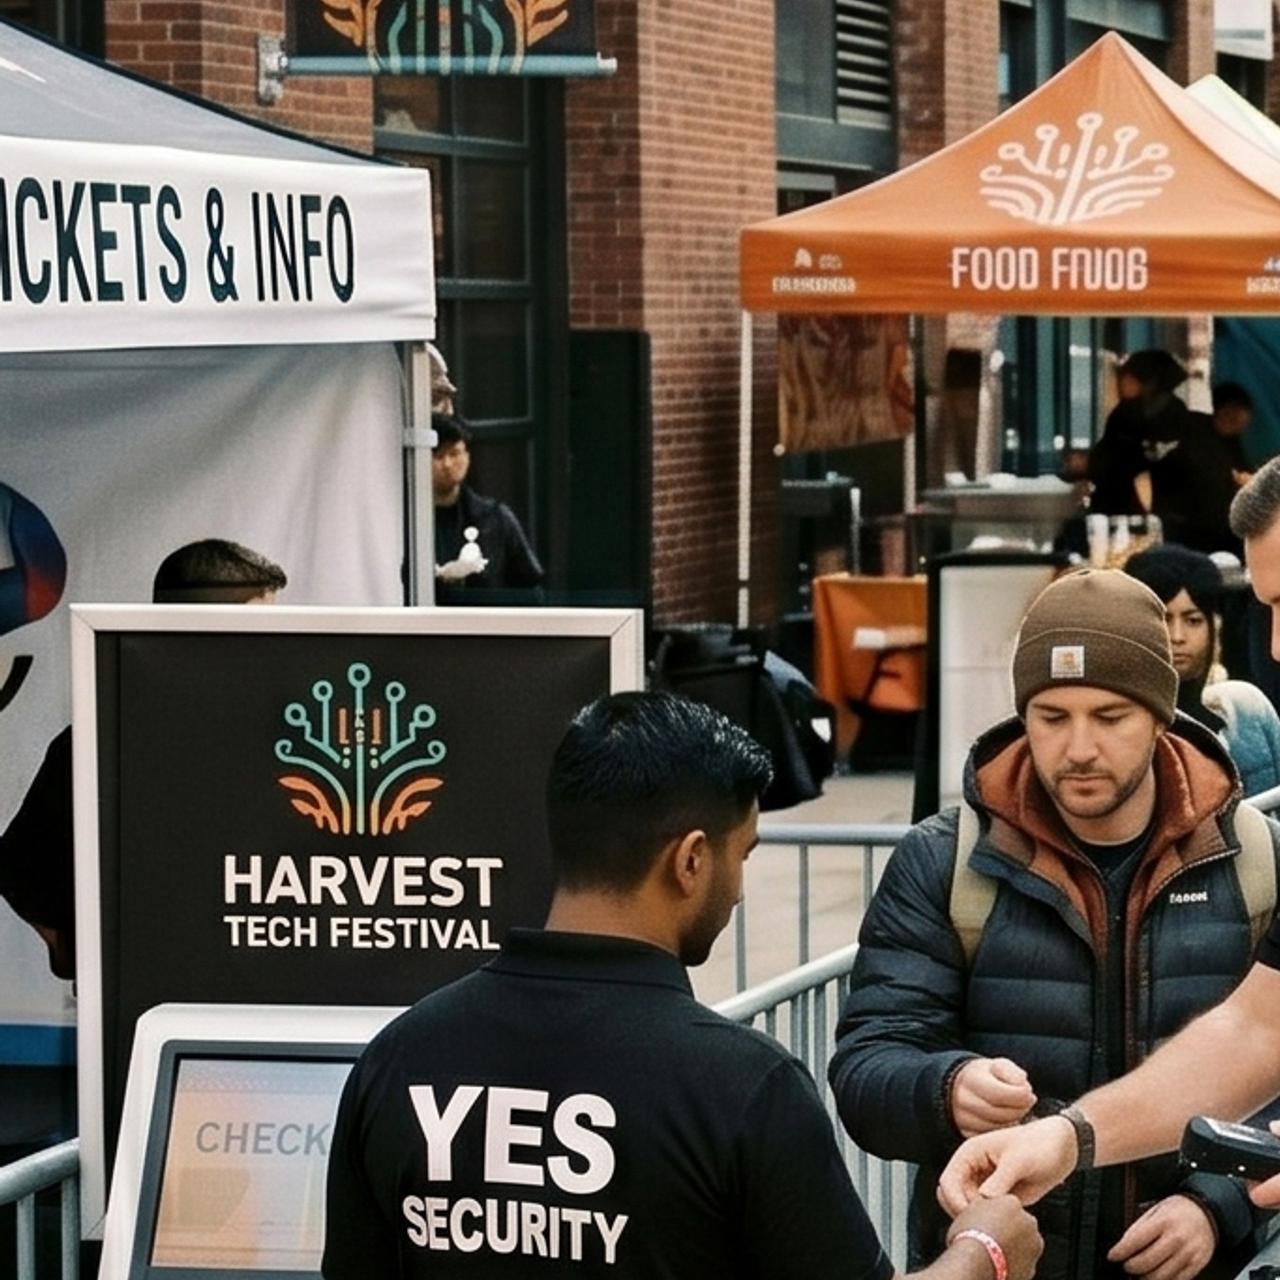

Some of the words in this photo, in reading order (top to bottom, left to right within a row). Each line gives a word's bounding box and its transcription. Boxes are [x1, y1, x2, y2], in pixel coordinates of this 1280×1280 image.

[0, 177, 188, 304] ICKETS
[206, 187, 238, 303] &
[251, 191, 355, 303] INFO
[950, 246, 1039, 292] FOOD
[223, 853, 503, 908] HARVEST
[223, 915, 317, 948] TECH
[330, 917, 501, 950] FESTIVAL
[408, 1084, 618, 1194] YES
[402, 1195, 629, 1264] SECURITY
